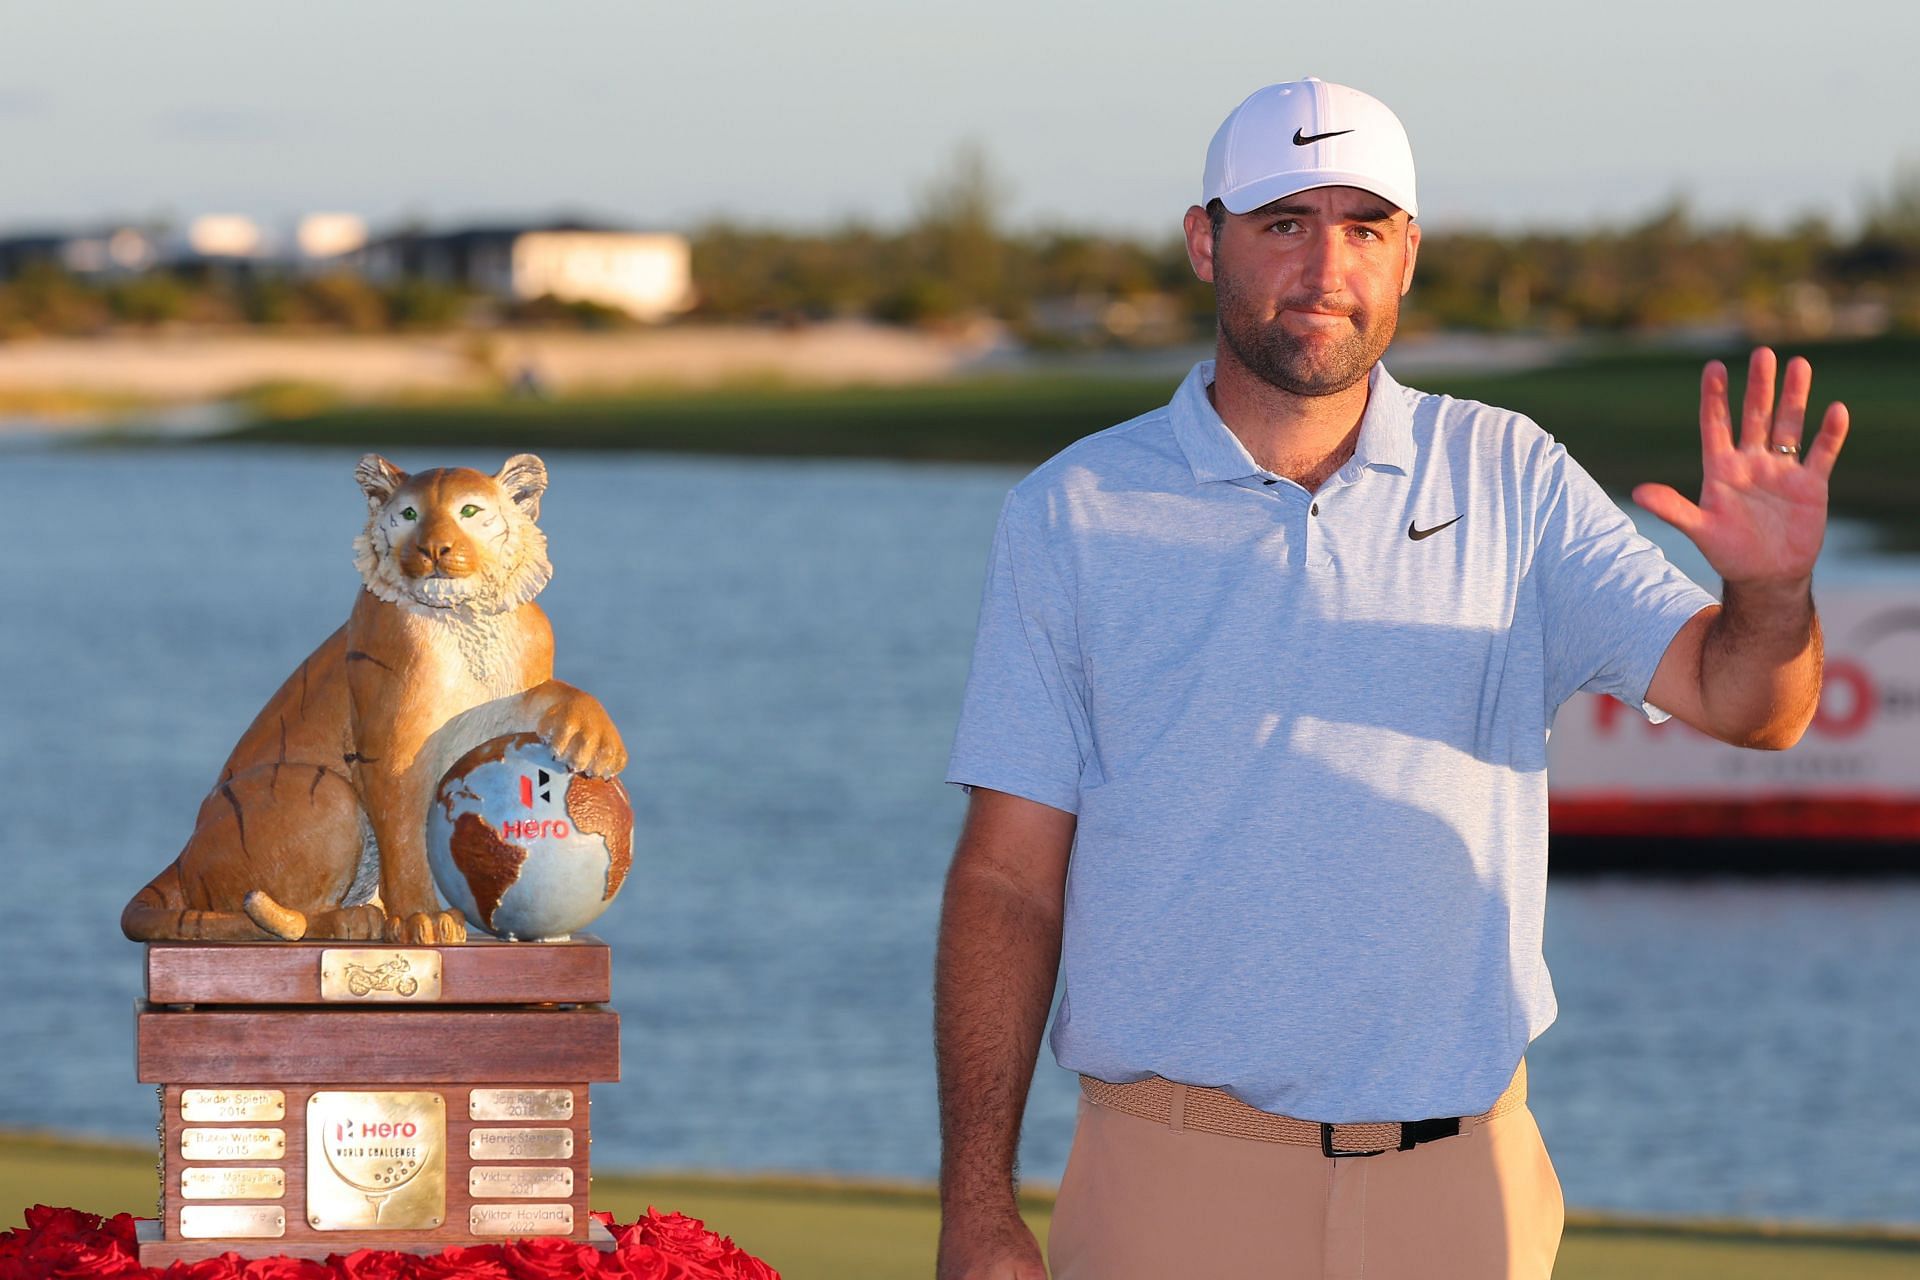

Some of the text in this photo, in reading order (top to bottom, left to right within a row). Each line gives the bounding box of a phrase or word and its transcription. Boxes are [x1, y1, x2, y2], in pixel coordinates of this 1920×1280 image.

[502, 819, 569, 839] Hero
[235, 1094, 269, 1106] Spieth
[518, 1094, 550, 1104] Ra
[220, 1107, 246, 1117] 2014
[362, 1122, 417, 1138] Hero
[232, 1133, 271, 1142] Watson
[480, 1133, 563, 1143] Henrik Stensn
[217, 1146, 249, 1155] 2015
[337, 1148, 416, 1157] WORLD CHALLENGE
[480, 1172, 512, 1181] Viktor
[480, 1210, 564, 1219] Viktor Hovland
[509, 1222, 535, 1232] 2022
